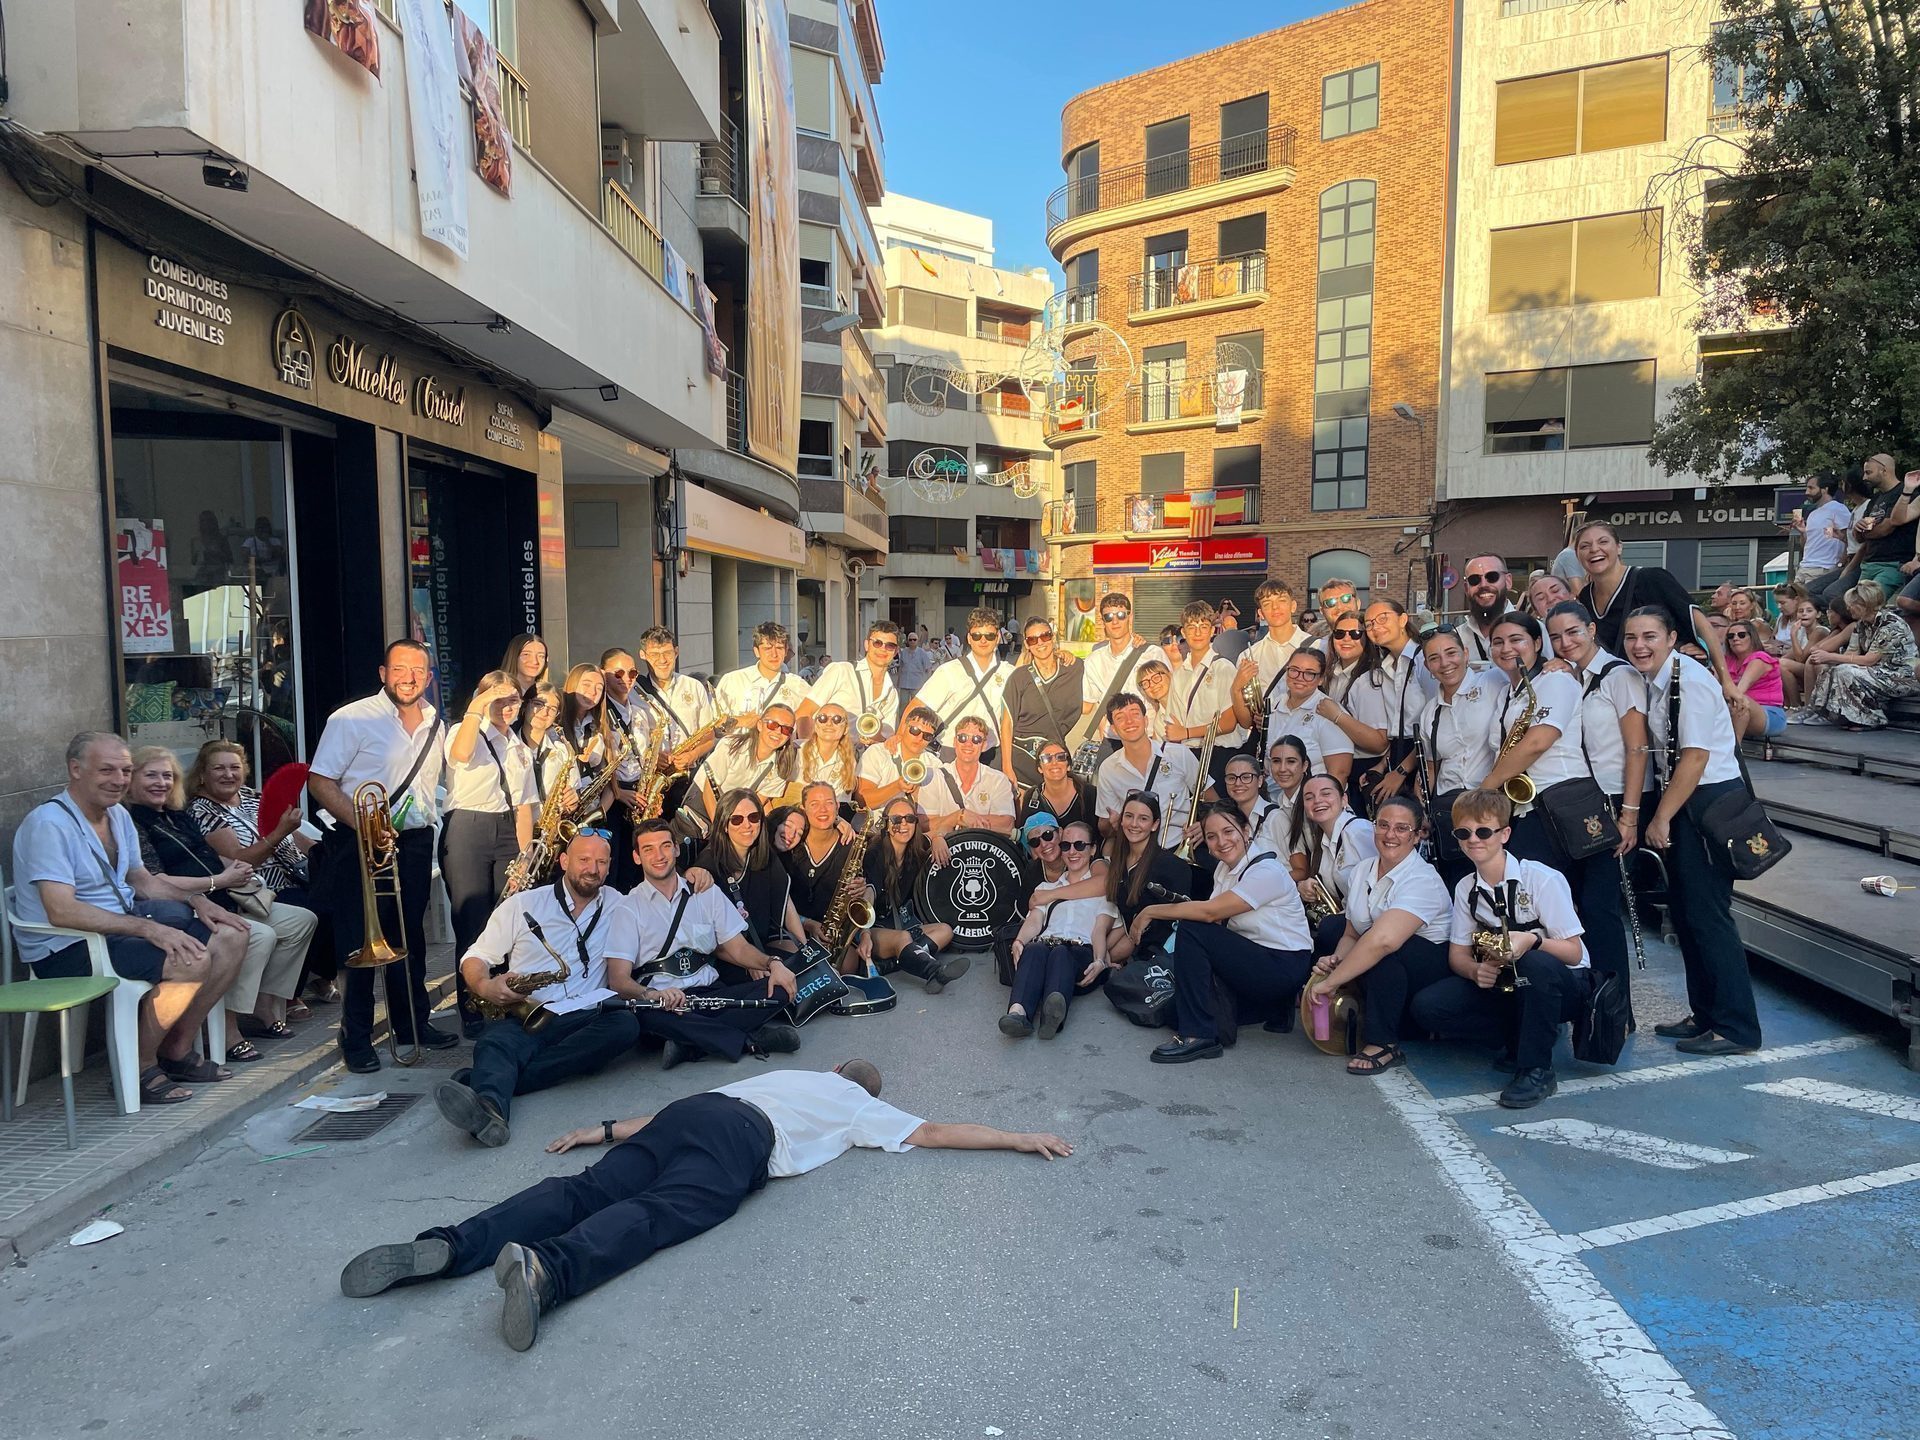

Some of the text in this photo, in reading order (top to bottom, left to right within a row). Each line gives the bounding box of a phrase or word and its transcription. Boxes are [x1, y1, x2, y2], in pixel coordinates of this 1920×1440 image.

[150, 255, 228, 300] COMEDORES
[148, 278, 232, 325] DORMITORIOS
[159, 309, 224, 345] JUVENILES
[330, 336, 466, 427] Muebles Cristel
[491, 415, 520, 435] COLCHONES
[487, 428, 525, 451] COMPLEMENTOS
[1610, 510, 1683, 526] OPTICA
[1151, 546, 1179, 563] Vidal
[121, 585, 152, 603] RE
[983, 583, 1010, 592] MILAR
[125, 620, 168, 638] XES
[929, 840, 1020, 879] SOTAT UNIO MUSICAL
[953, 925, 993, 937] ALBERIC
